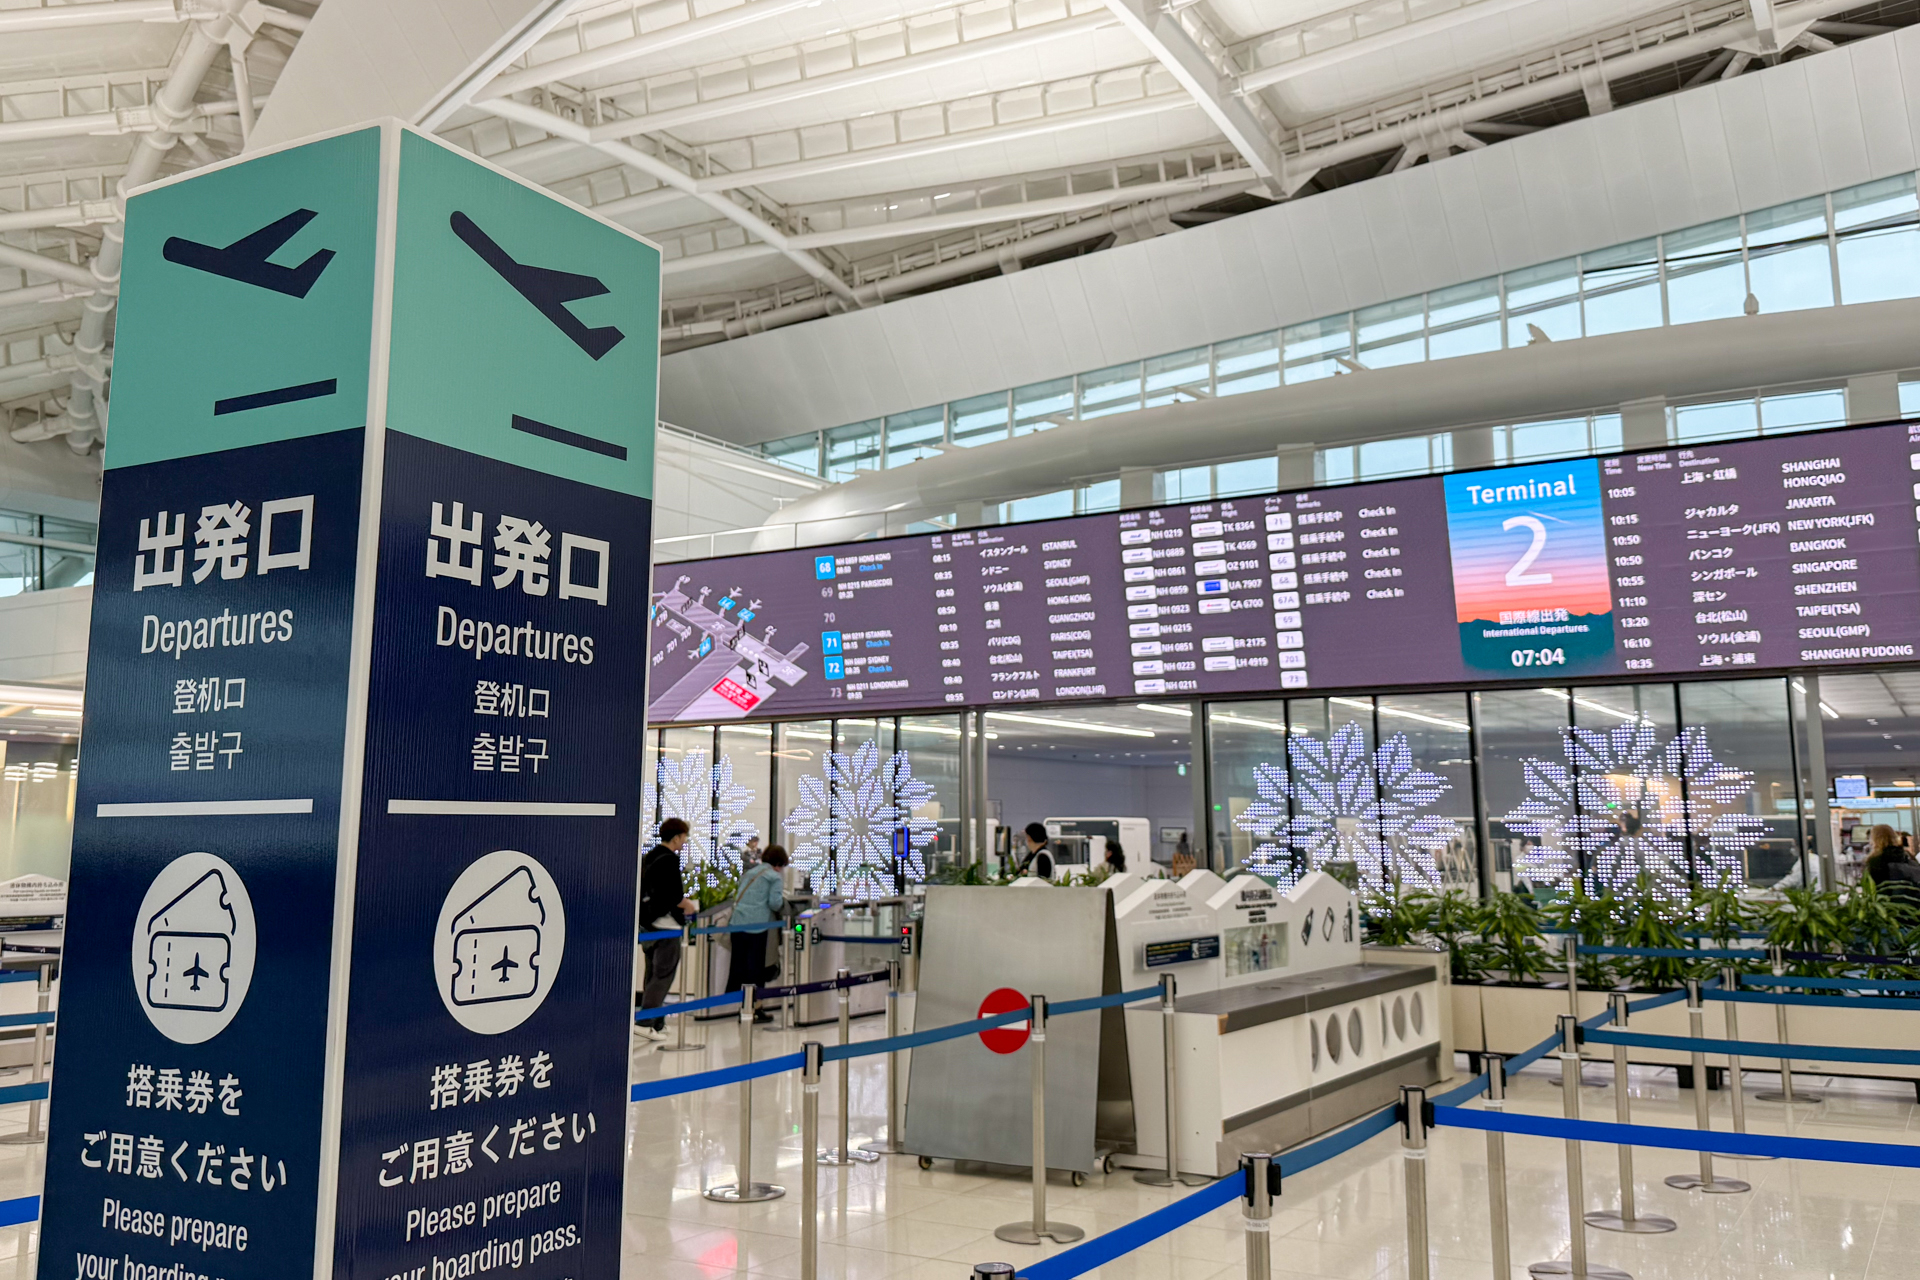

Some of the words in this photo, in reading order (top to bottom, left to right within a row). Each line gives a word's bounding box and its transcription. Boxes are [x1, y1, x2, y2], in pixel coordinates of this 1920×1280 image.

[1782, 458, 1840, 473] SHANGHAI
[1784, 473, 1845, 488] HONGQIAO
[1466, 474, 1576, 505] Terminal
[1608, 487, 1636, 498] 10:05
[1786, 496, 1836, 509] JAKARTA
[1358, 507, 1386, 518] Check
[1386, 506, 1396, 515] In
[1684, 504, 1739, 519] ジャカルタ
[1610, 514, 1639, 525] 10:15
[1788, 519, 1812, 530] NEW
[1812, 513, 1874, 529] YORK(JFK)
[1222, 522, 1234, 533] TK
[1360, 528, 1388, 538] Check
[1388, 527, 1398, 535] In
[1687, 522, 1780, 539] ニューヨーク(JFK)
[1150, 529, 1163, 540] NH
[1164, 528, 1183, 538] 0219
[133, 495, 314, 592] 出発口
[1612, 535, 1641, 546] 10:50
[1790, 538, 1846, 552] BANGKOK
[1224, 541, 1237, 552] TK
[1501, 515, 1553, 587] 2
[426, 501, 610, 606] 出発口
[1152, 548, 1166, 559] NH
[1362, 548, 1389, 558] Check
[1390, 547, 1400, 556] In
[1614, 555, 1643, 566] 10:50
[820, 562, 831, 573] 68
[982, 566, 1009, 576] シドニー
[1154, 567, 1168, 577] NH
[1226, 561, 1239, 572] OZ
[1792, 559, 1858, 574] SINGAPORE
[1364, 568, 1392, 578] Check
[1392, 568, 1402, 576] In
[1228, 580, 1242, 591] UA
[1617, 576, 1645, 586] 10:55
[822, 587, 833, 597] 69
[1156, 586, 1169, 596] NH
[1366, 589, 1393, 599] Check
[1394, 588, 1404, 597] In
[1794, 581, 1857, 595] SHENZHEN
[1230, 600, 1243, 610] CA
[1619, 596, 1647, 607] 11:10
[1158, 605, 1170, 615] NH
[1796, 602, 1860, 616] TAIPEI(TSA)
[824, 612, 835, 622] 70
[1499, 608, 1569, 625] 国際線出発
[1621, 617, 1649, 628] 13:20
[141, 608, 293, 660] Departures
[1159, 623, 1173, 634] NH
[1172, 623, 1192, 633] 0215
[1483, 626, 1539, 638] International
[1539, 625, 1589, 636] Departures
[1799, 624, 1870, 638] SEOUL(GMP)
[437, 606, 593, 664] Departures
[826, 638, 837, 648] 71
[1161, 642, 1175, 653] NH
[1623, 638, 1652, 648] 16:10
[1512, 648, 1565, 666] 07:04
[1801, 648, 1860, 660] SHANGHAI
[1862, 645, 1913, 657] PUDONG
[828, 662, 840, 673] 72
[1163, 661, 1177, 672] NH
[1235, 658, 1248, 668] LH
[1625, 659, 1654, 669] 18:35
[1165, 680, 1178, 691] NH
[1177, 680, 1197, 690] 0211
[173, 677, 245, 714] 登机口
[830, 687, 842, 698] 73
[474, 680, 549, 718] 登机口
[170, 731, 243, 770] 출발구
[472, 733, 548, 773] 출발구
[813, 929, 818, 938] 4
[796, 935, 802, 945] 3
[902, 937, 909, 948] 4
[430, 1051, 553, 1110] 搭乗券を
[126, 1064, 242, 1115] 搭乗券を
[379, 1112, 596, 1188] ご用意ください
[81, 1130, 286, 1191] ご用意ください
[406, 1202, 476, 1241] Please
[483, 1181, 560, 1227] prepare
[103, 1198, 164, 1237] Please
[171, 1216, 247, 1252] prepare
[432, 1238, 523, 1280] boarding
[530, 1224, 581, 1263] pass.
[75, 1252, 118, 1280] your
